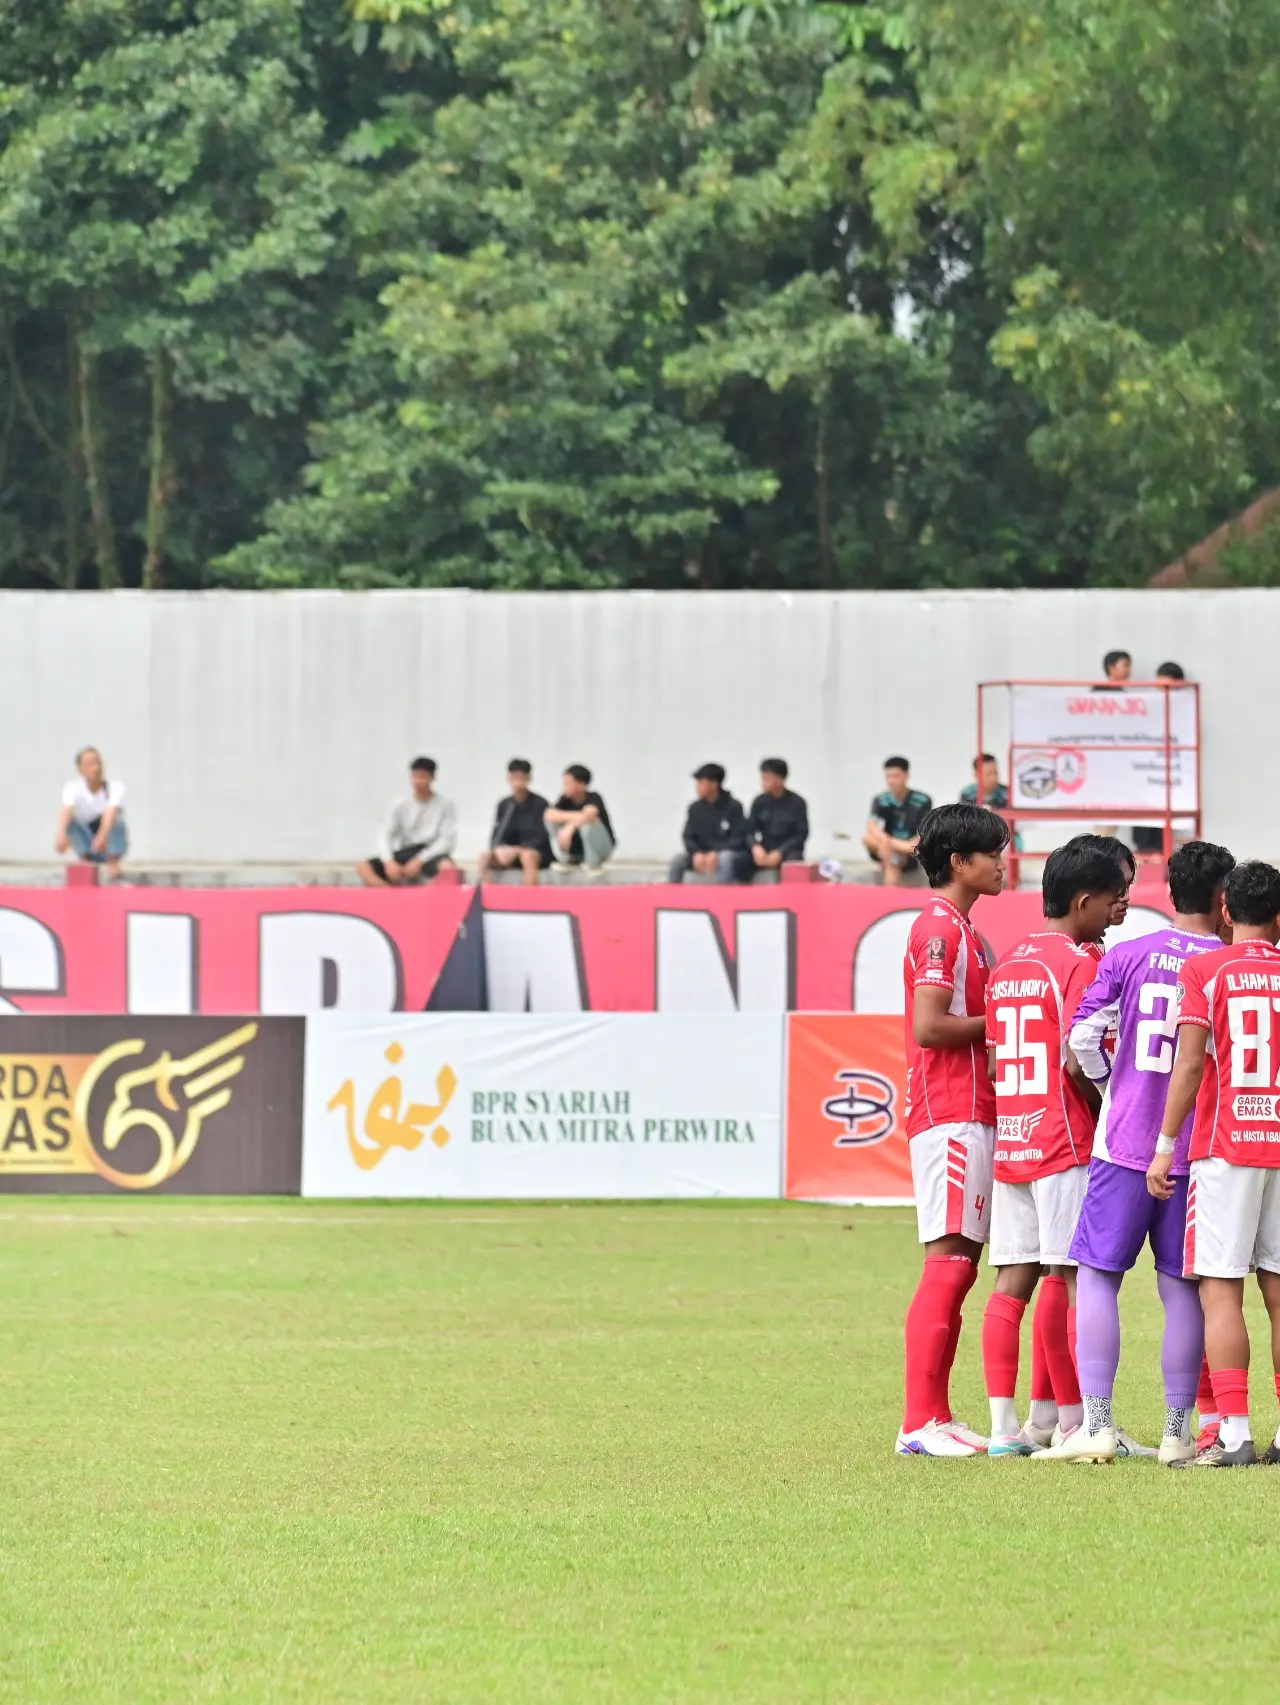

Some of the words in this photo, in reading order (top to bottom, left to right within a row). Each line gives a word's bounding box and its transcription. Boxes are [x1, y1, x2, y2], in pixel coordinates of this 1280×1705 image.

[1226, 973, 1269, 991] ILHAM
[1135, 982, 1180, 1074] 2
[0, 1064, 70, 1100] DA
[472, 1091, 517, 1114] BPR
[525, 1091, 631, 1114] SYARIAH
[1237, 1096, 1272, 1106] GARDA
[1237, 1106, 1272, 1117] EMAS
[472, 1119, 548, 1142] BUANA
[556, 1119, 634, 1142] MITRA
[644, 1119, 755, 1143] PERWIRA
